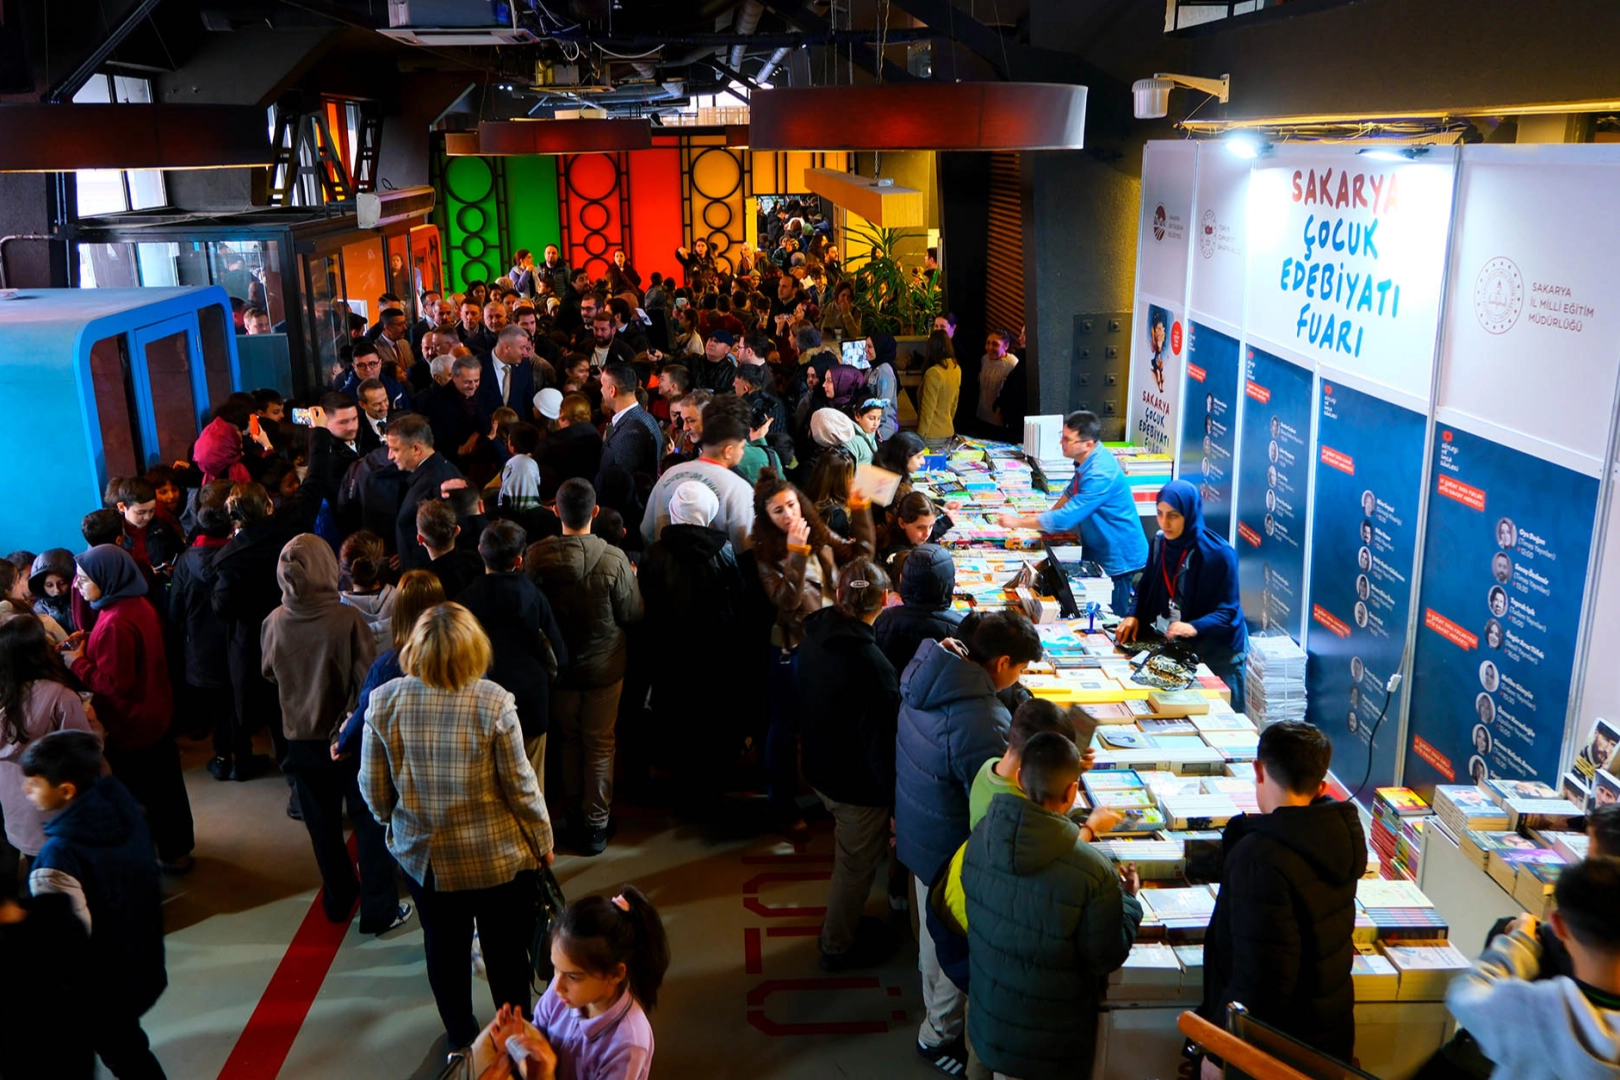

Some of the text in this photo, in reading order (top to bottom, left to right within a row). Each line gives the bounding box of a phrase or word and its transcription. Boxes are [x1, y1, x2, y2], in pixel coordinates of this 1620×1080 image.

[1292, 167, 1398, 215] SAKARYA
[1303, 214, 1379, 261] ÇOCUK
[1280, 257, 1400, 319] EDEBİYATI
[1532, 282, 1572, 297] SAKARYA
[1530, 295, 1537, 308] İL
[1563, 301, 1595, 317] EĞİTİM
[1297, 303, 1364, 358] FUARI
[1528, 313, 1583, 332] MÜDÜRLÜĞÜ
[1142, 390, 1170, 415] SAKARYA
[1144, 406, 1165, 428] ÇOCUK
[1138, 419, 1170, 448] EDEBİYATI
